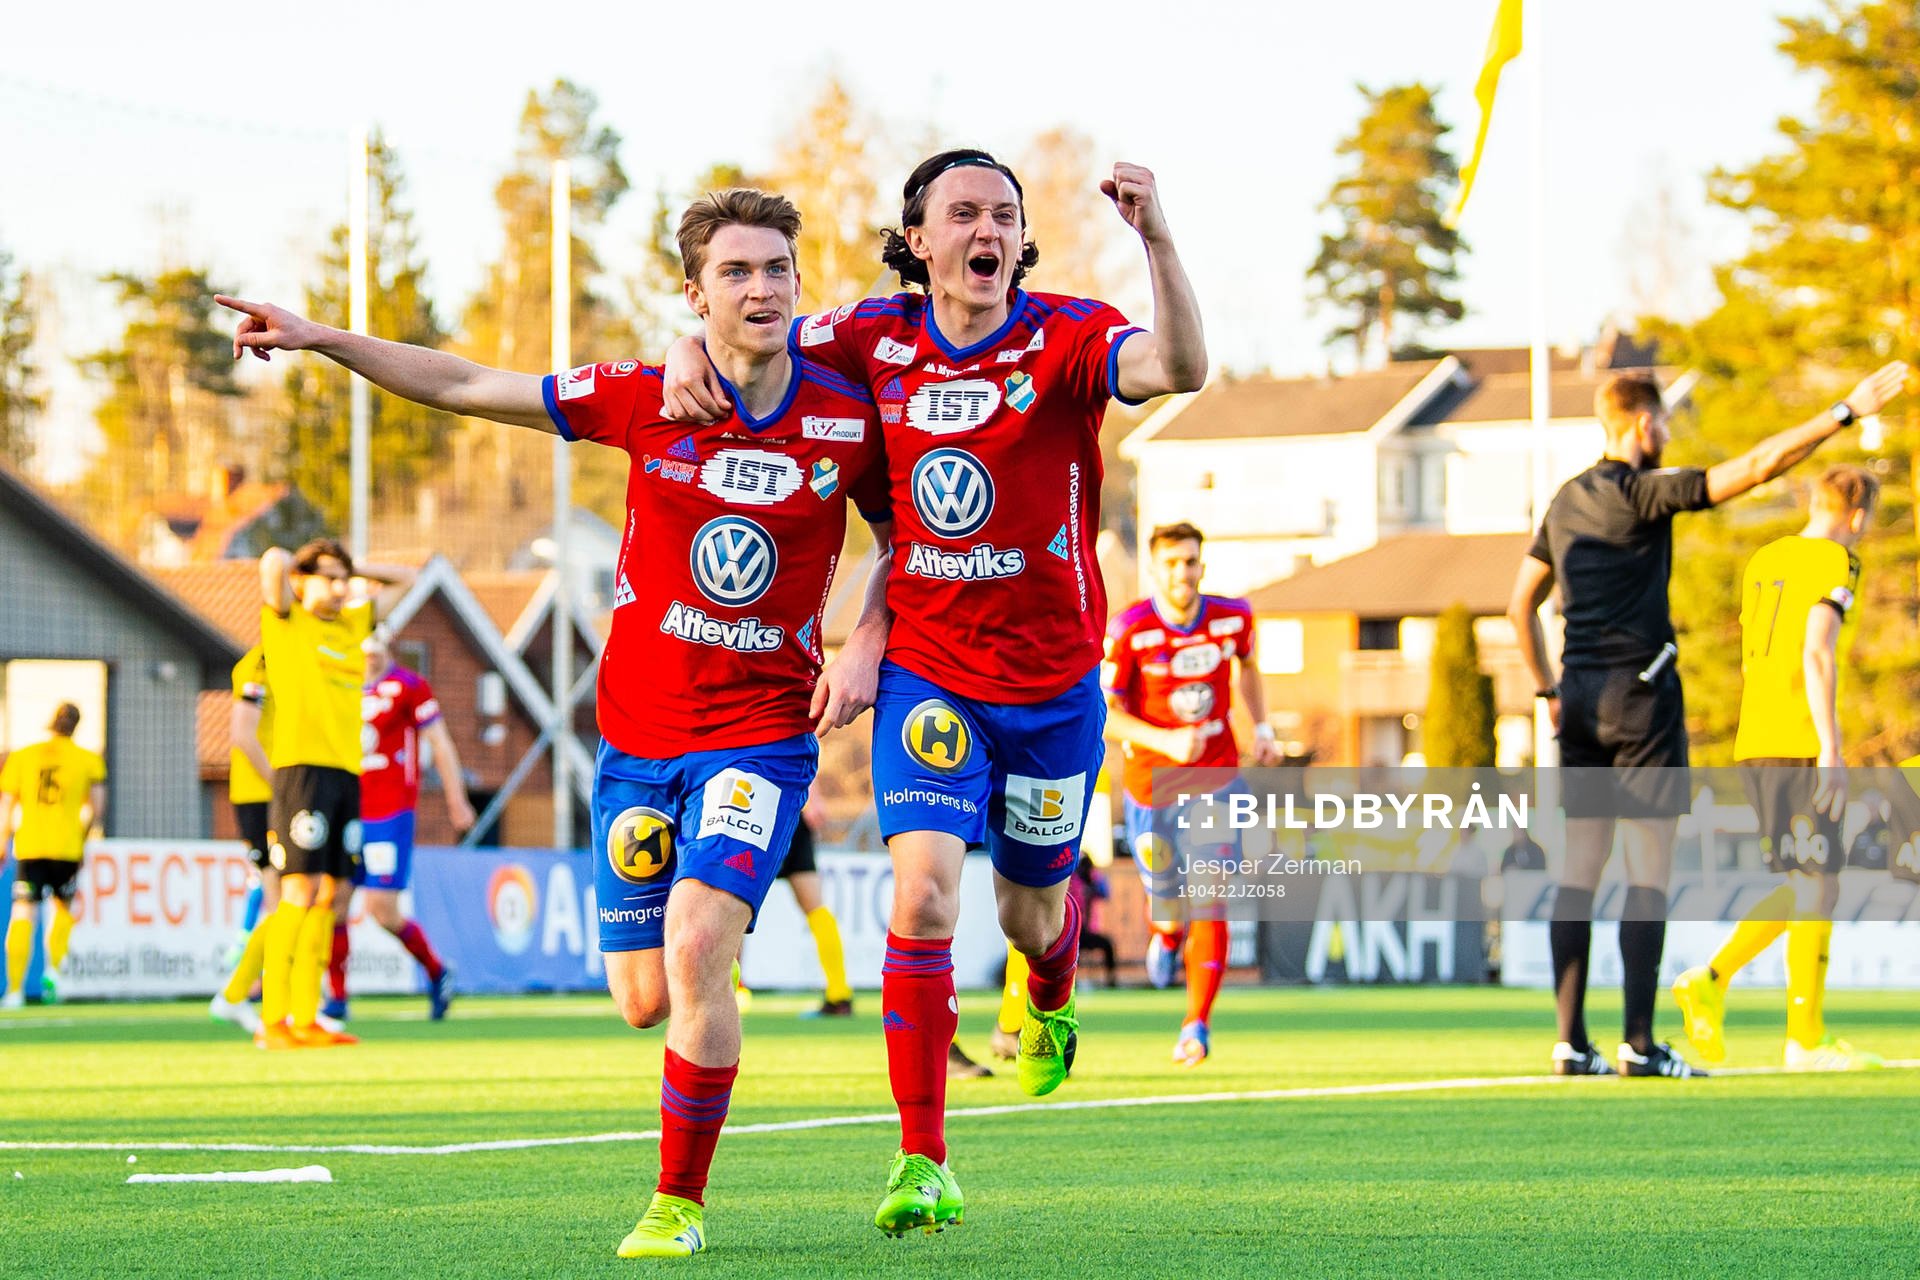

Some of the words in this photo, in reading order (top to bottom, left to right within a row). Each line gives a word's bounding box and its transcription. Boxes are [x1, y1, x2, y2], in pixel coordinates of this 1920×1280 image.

[928, 389, 989, 422] IST
[832, 430, 861, 439] PRODUKT
[660, 469, 693, 484] SPORT
[661, 459, 698, 476] INTER
[721, 456, 788, 496] IST
[1069, 461, 1087, 613] ONEPARTNERGROUP
[906, 543, 1026, 581] Atteviks
[661, 601, 784, 652] Atteviks
[883, 787, 960, 811] Holmgrens
[962, 798, 978, 814] Bil
[706, 814, 763, 836] BALCO
[1015, 821, 1074, 837] BALCO
[1304, 873, 1458, 983] AKH
